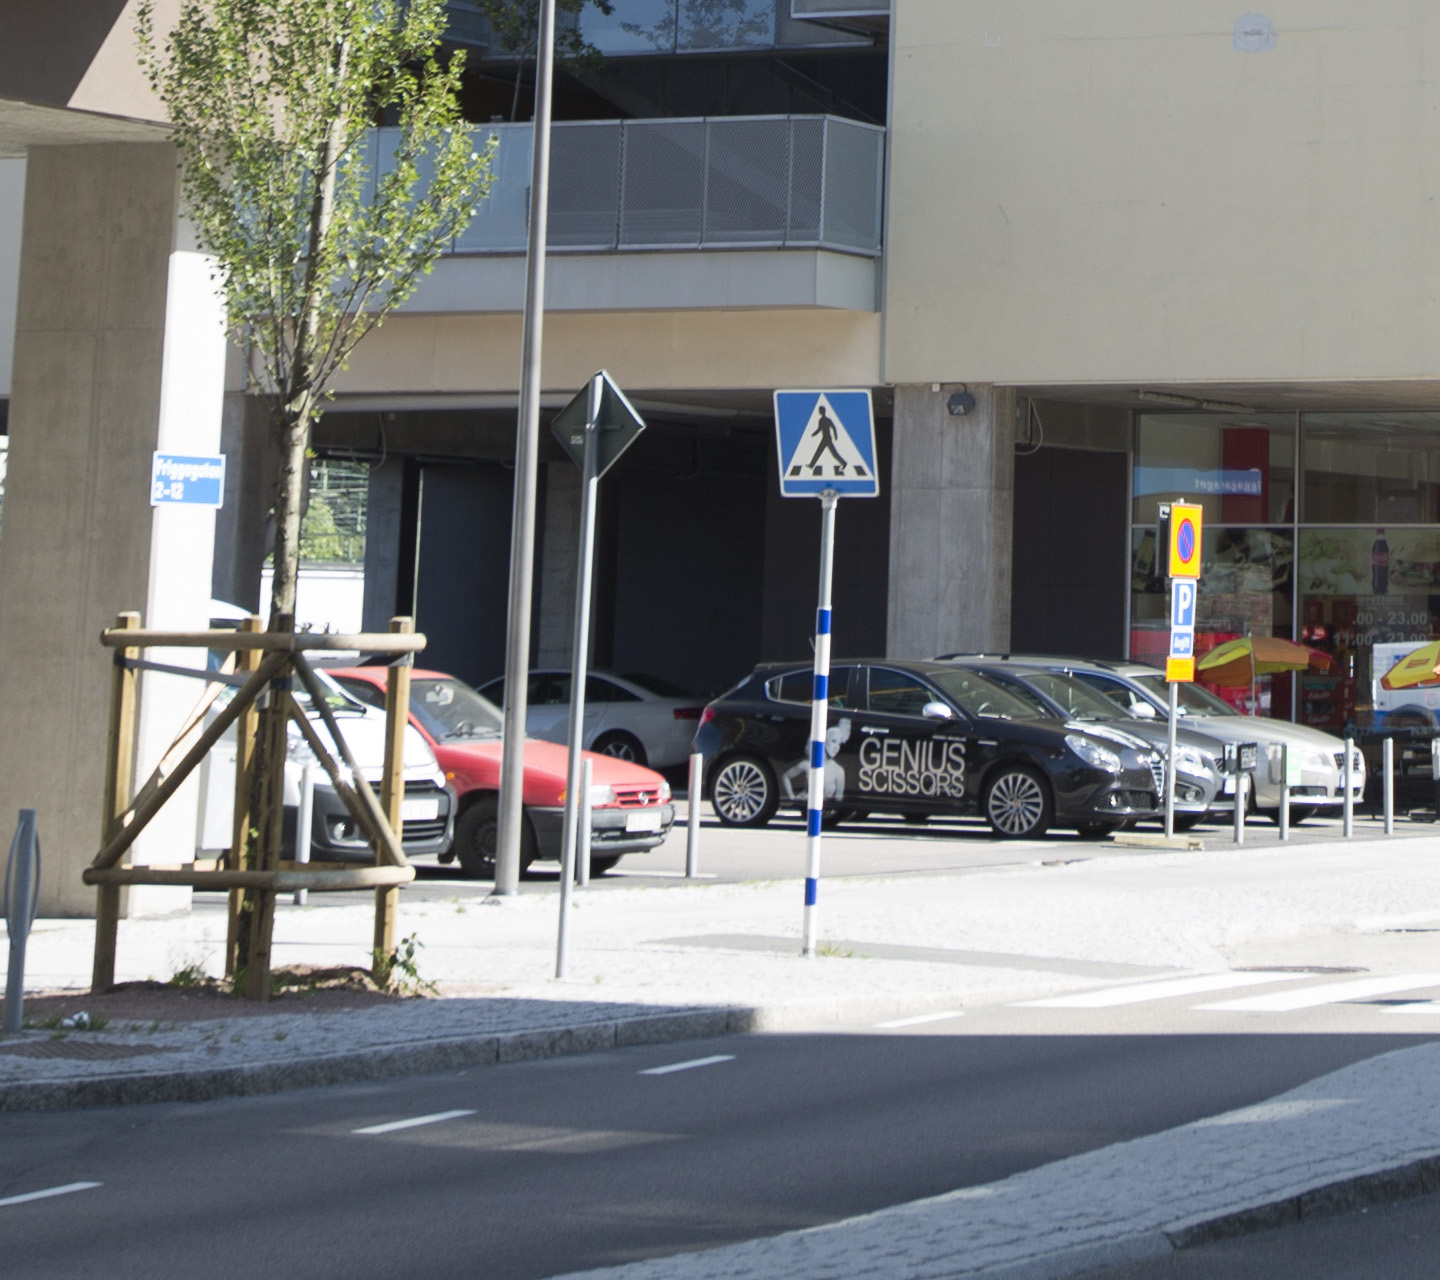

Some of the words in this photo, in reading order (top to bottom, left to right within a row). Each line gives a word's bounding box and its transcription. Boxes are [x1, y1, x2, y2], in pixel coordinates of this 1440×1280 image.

[155, 481, 184, 500] 2-12
[1178, 584, 1192, 625] P
[859, 737, 966, 775] GENIUS
[858, 767, 965, 798] SCISSORS
